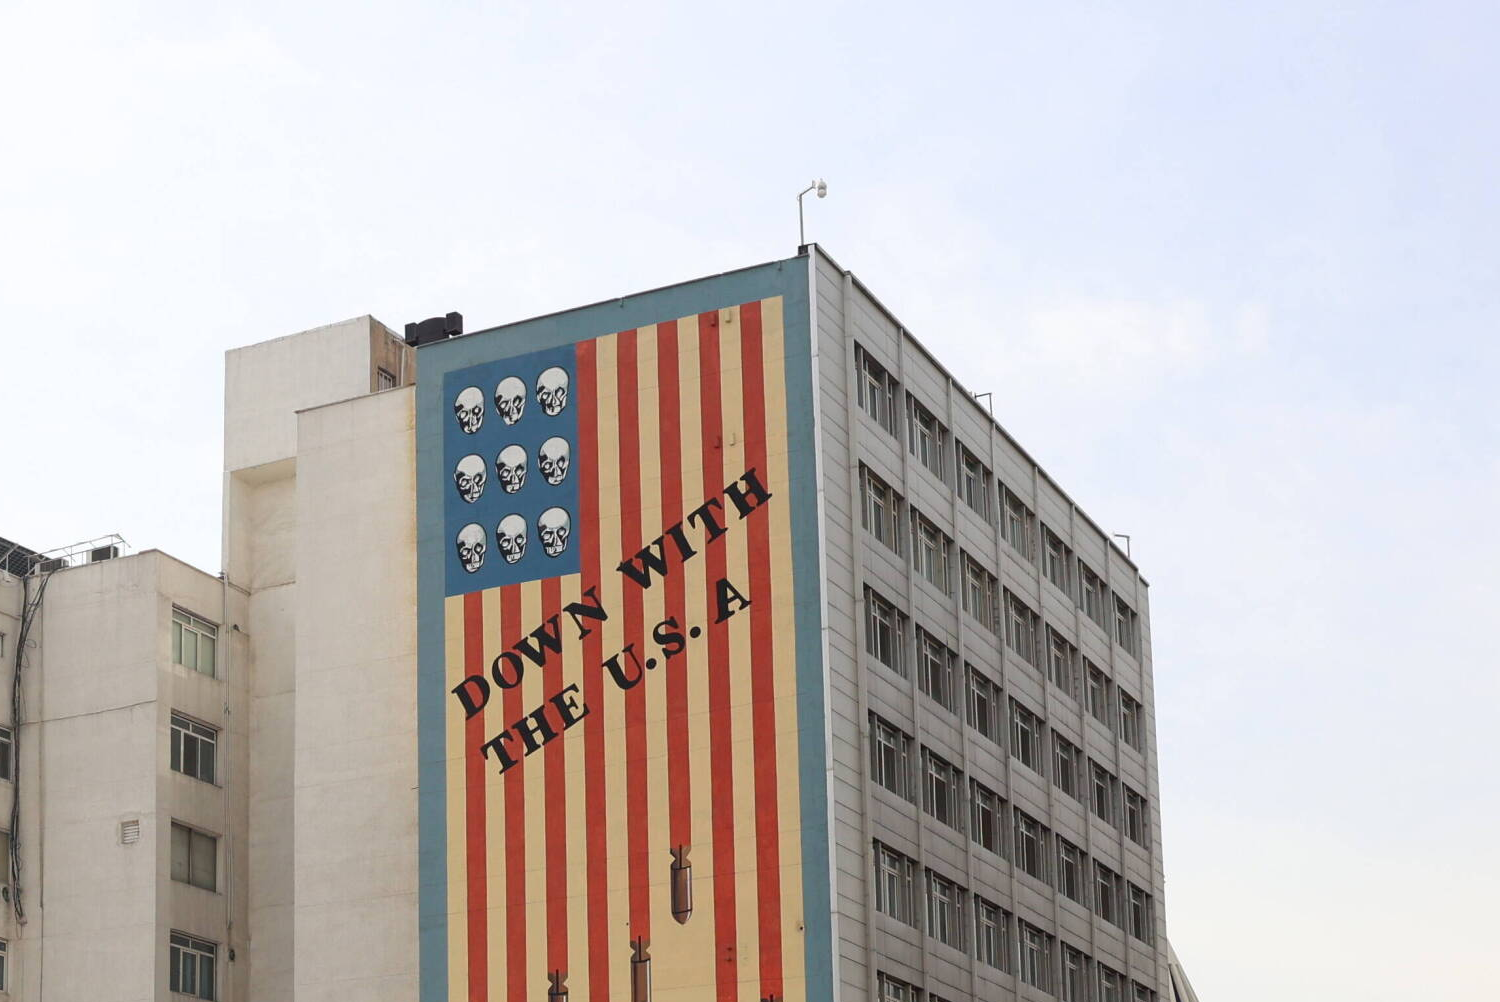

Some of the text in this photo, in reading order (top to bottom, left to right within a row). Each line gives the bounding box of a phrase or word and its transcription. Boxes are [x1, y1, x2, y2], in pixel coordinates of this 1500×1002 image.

[451, 467, 773, 721] DOWN WITH
[480, 683, 591, 775] THE
